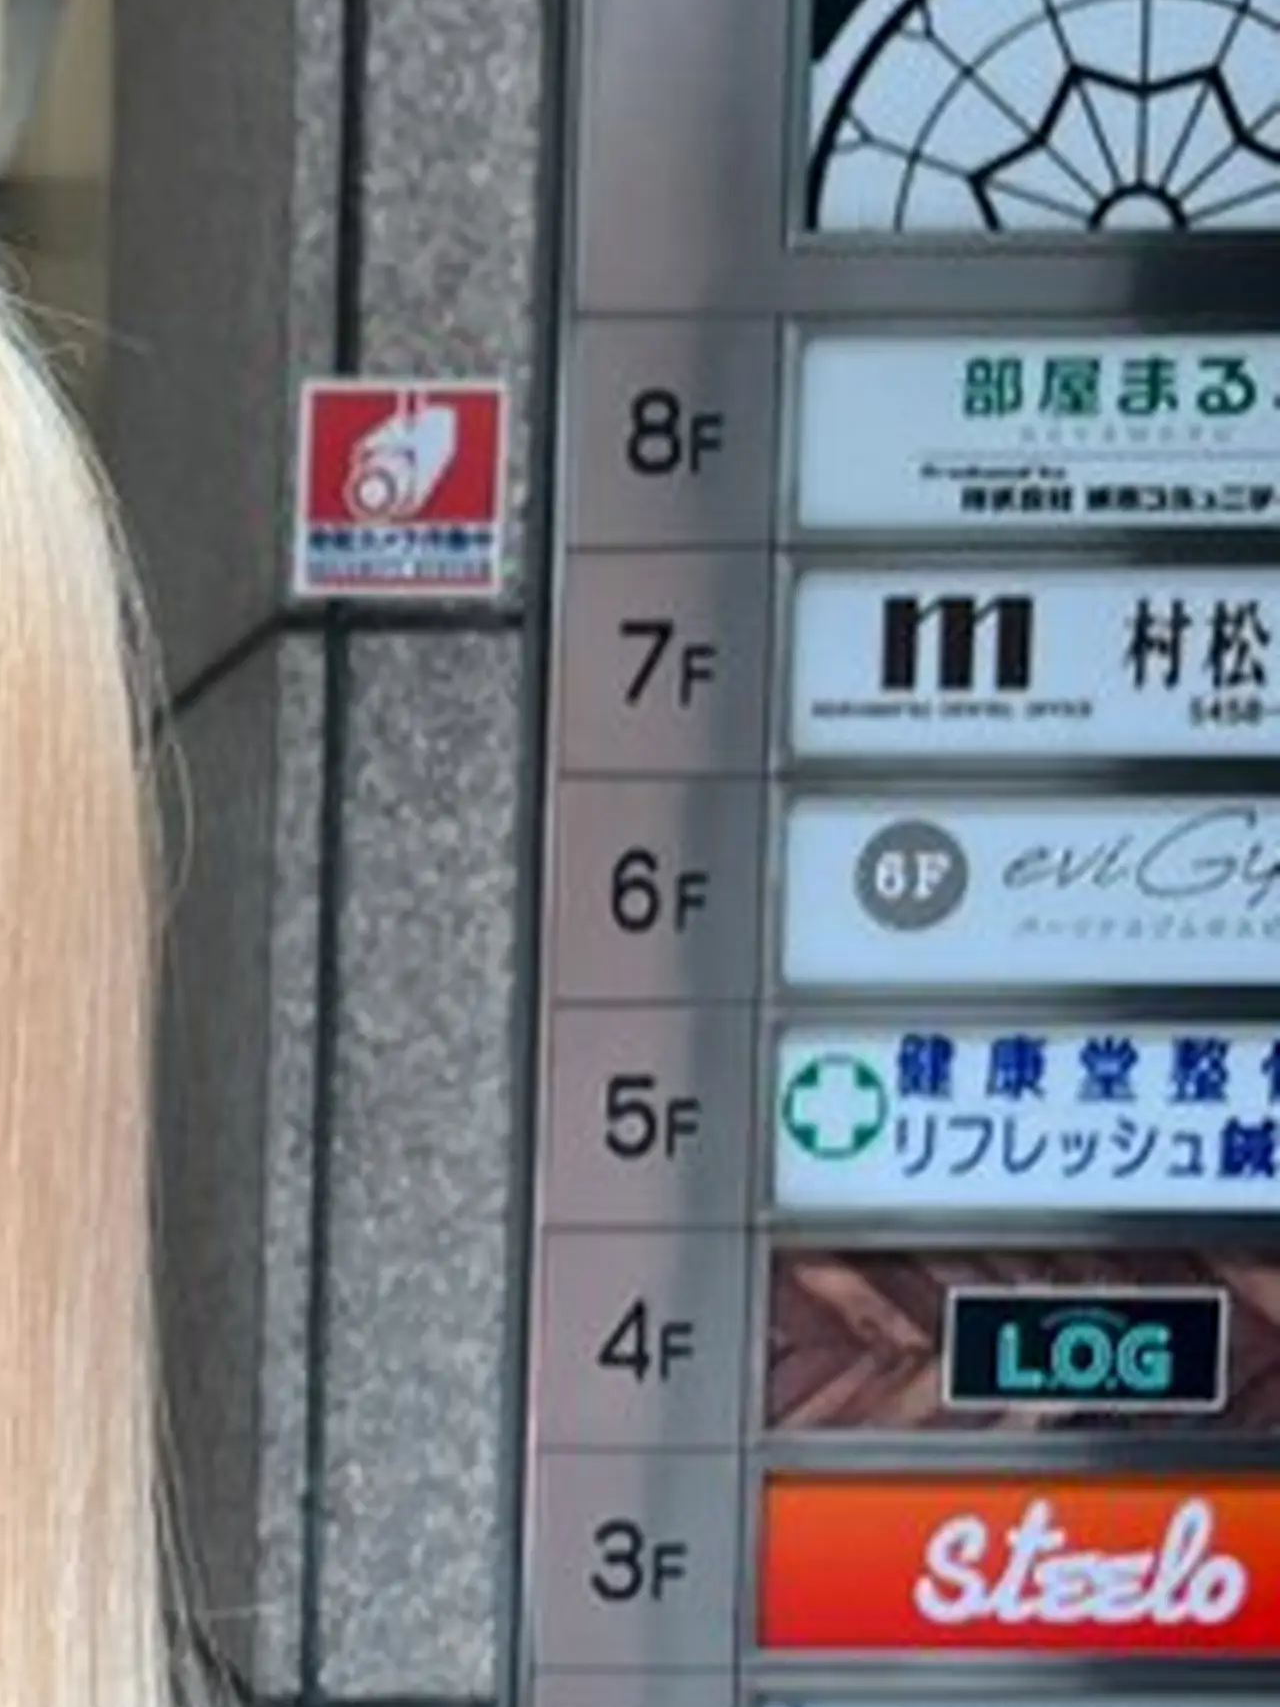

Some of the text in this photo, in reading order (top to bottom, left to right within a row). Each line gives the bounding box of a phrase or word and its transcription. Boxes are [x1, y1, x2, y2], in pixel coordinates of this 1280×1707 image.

[965, 357, 1280, 415] 部屋まる
[627, 389, 721, 475] 8F
[620, 620, 715, 705] 7F
[1128, 600, 1270, 688] 村松
[612, 849, 706, 933] 6F
[606, 1075, 699, 1158] 5F
[598, 1301, 692, 1380] 4F
[591, 1520, 686, 1601] 3F
